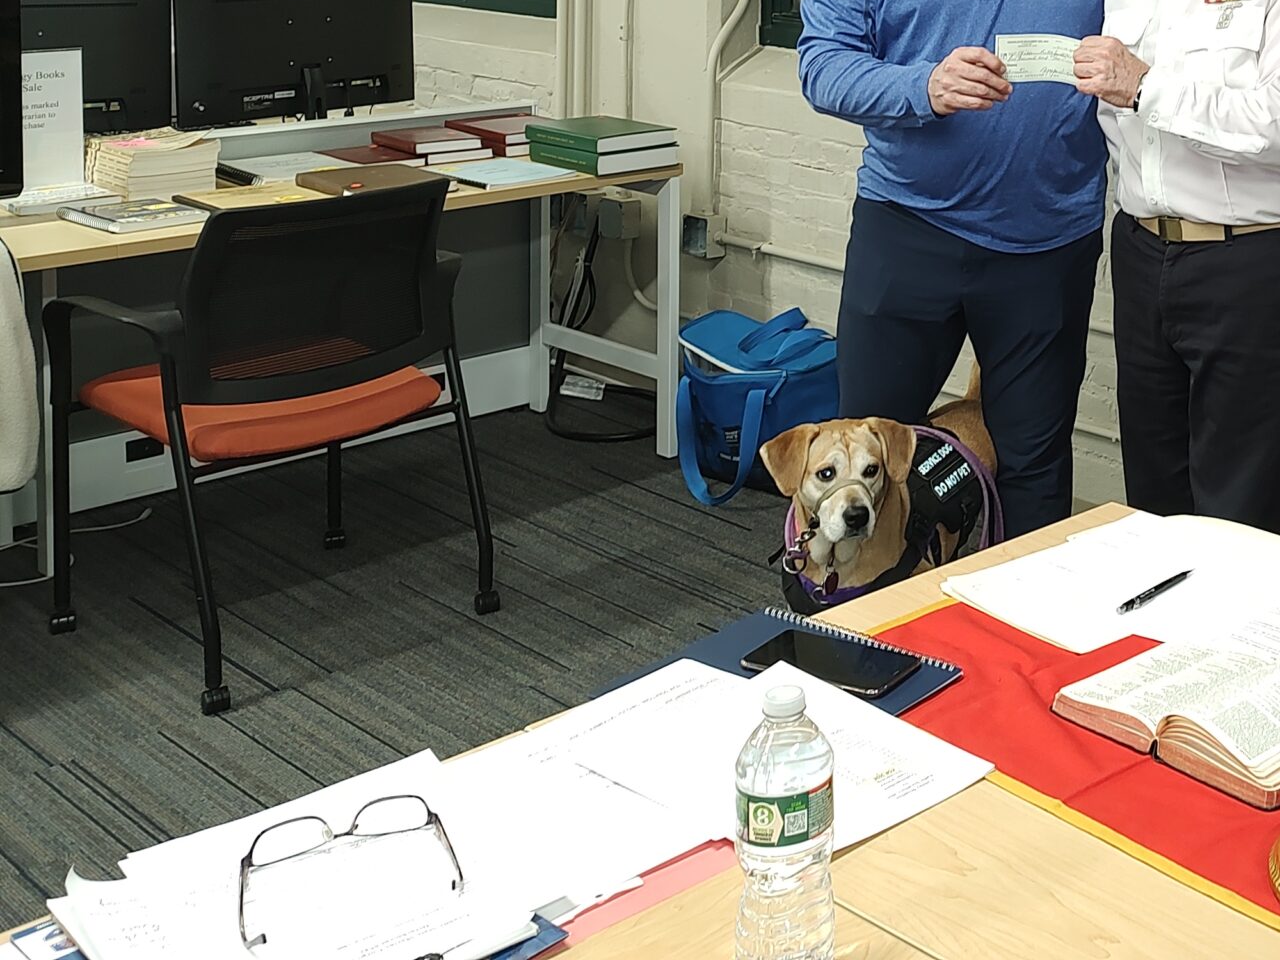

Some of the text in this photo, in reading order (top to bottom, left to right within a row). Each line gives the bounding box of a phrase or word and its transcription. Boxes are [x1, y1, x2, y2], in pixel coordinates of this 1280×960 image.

[35, 70, 65, 80] Books
[23, 83, 43, 92] Sale
[31, 101, 59, 110] marked
[23, 112, 46, 120] rarian
[24, 122, 45, 130] chase
[917, 443, 953, 476] SERVICE DOG
[934, 462, 971, 497] DO NOT PET
